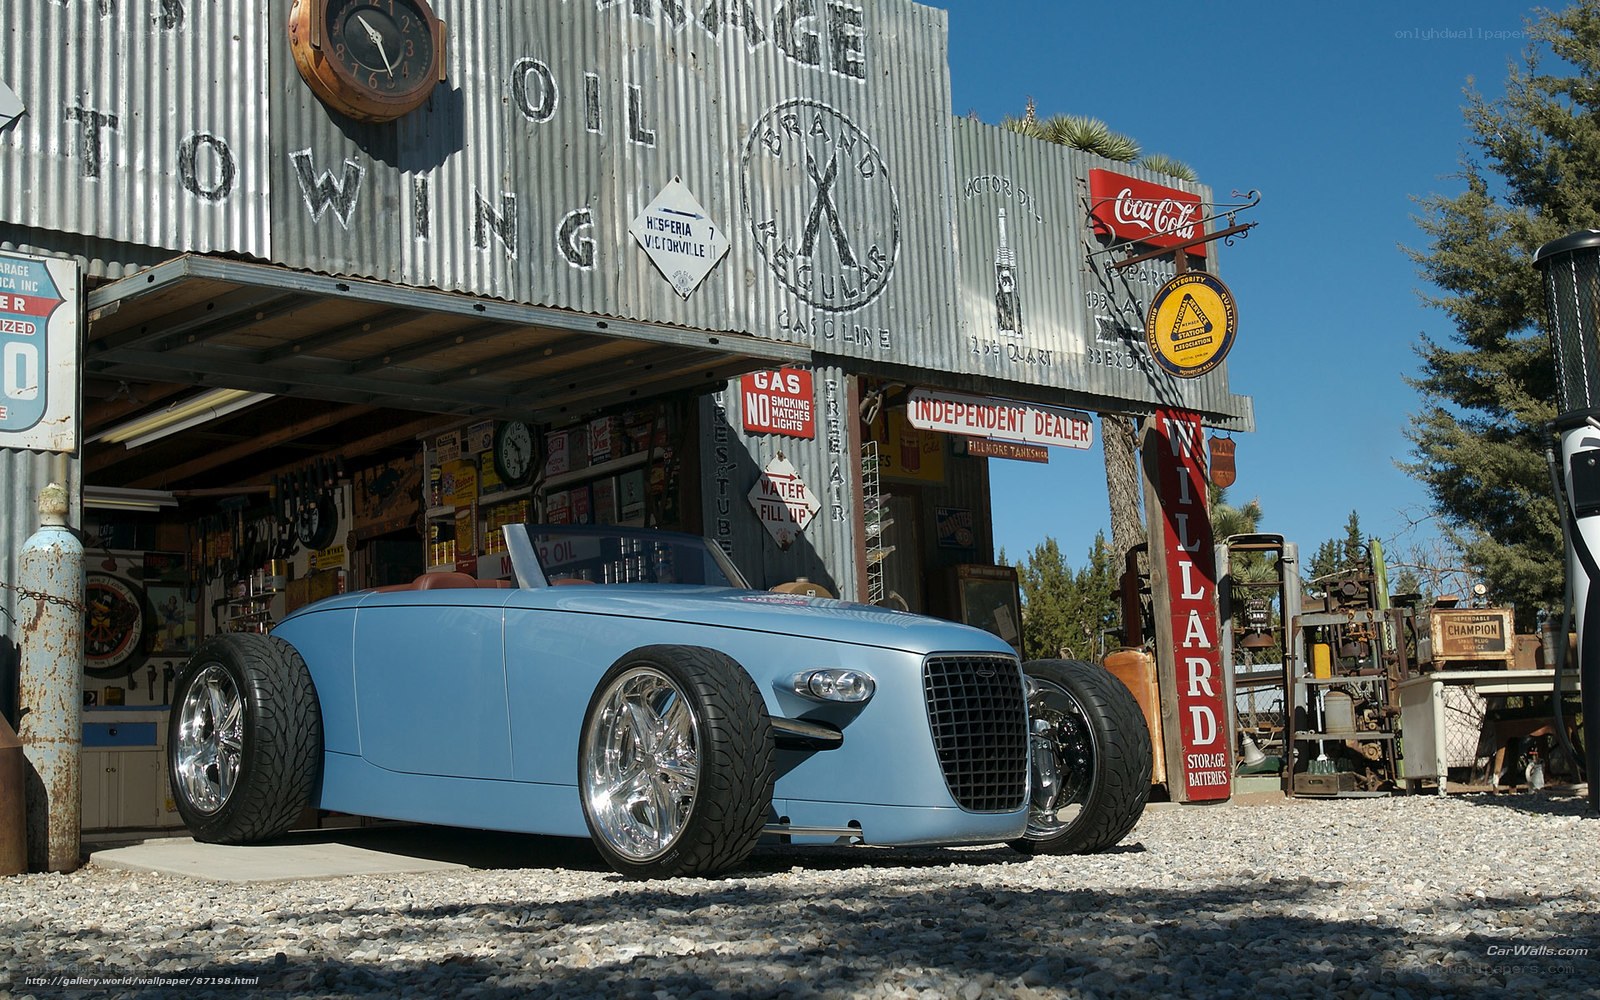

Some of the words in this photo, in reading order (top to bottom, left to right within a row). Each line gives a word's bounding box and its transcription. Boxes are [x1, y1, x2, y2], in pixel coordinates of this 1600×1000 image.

[401, 15, 410, 33] 2
[336, 43, 345, 61] 8
[406, 40, 414, 57] 3
[351, 63, 359, 78] 7
[368, 72, 378, 89] 6
[510, 56, 656, 149] OIL
[760, 111, 879, 180] BRAND
[1114, 187, 1195, 240] Coca-Cola
[646, 216, 692, 237] HESPERIA
[709, 227, 716, 241] 7
[644, 234, 705, 257] VICTORVILLE
[21, 279, 39, 293] INC
[1168, 276, 1207, 291] INTEGRITY
[0, 296, 26, 312] ER
[1220, 292, 1234, 335] QUALITY
[1172, 298, 1189, 334] NATIONAL
[1188, 298, 1209, 327] SERVICE
[1181, 319, 1200, 328] MEMBER
[0, 320, 37, 336] IZED
[777, 308, 891, 350] GASOLINE
[1150, 307, 1159, 354] LEADERSHIP
[1177, 327, 1206, 340] STATION
[1174, 336, 1212, 351] ASSOCIATION
[1007, 343, 1053, 367] QUART
[754, 370, 800, 394] GAS
[746, 393, 770, 428] NO
[771, 396, 810, 411] SMOKING
[772, 407, 811, 421] MATCHES
[823, 378, 842, 456] FREE
[915, 396, 1027, 433] INDEPENDENT
[1035, 411, 1089, 441] DEALER
[772, 418, 803, 432] LIGHTS
[968, 440, 1008, 456] FILLMORE
[760, 479, 806, 500] WATER
[829, 463, 846, 523] AIR
[761, 503, 784, 523] FILL
[788, 508, 806, 524] UP
[553, 541, 577, 563] OIL
[1162, 417, 1218, 747] WILLARD
[1448, 624, 1497, 636] CHAMPION
[1187, 753, 1226, 770] STORAGE
[1188, 770, 1228, 788] BATTERIES
